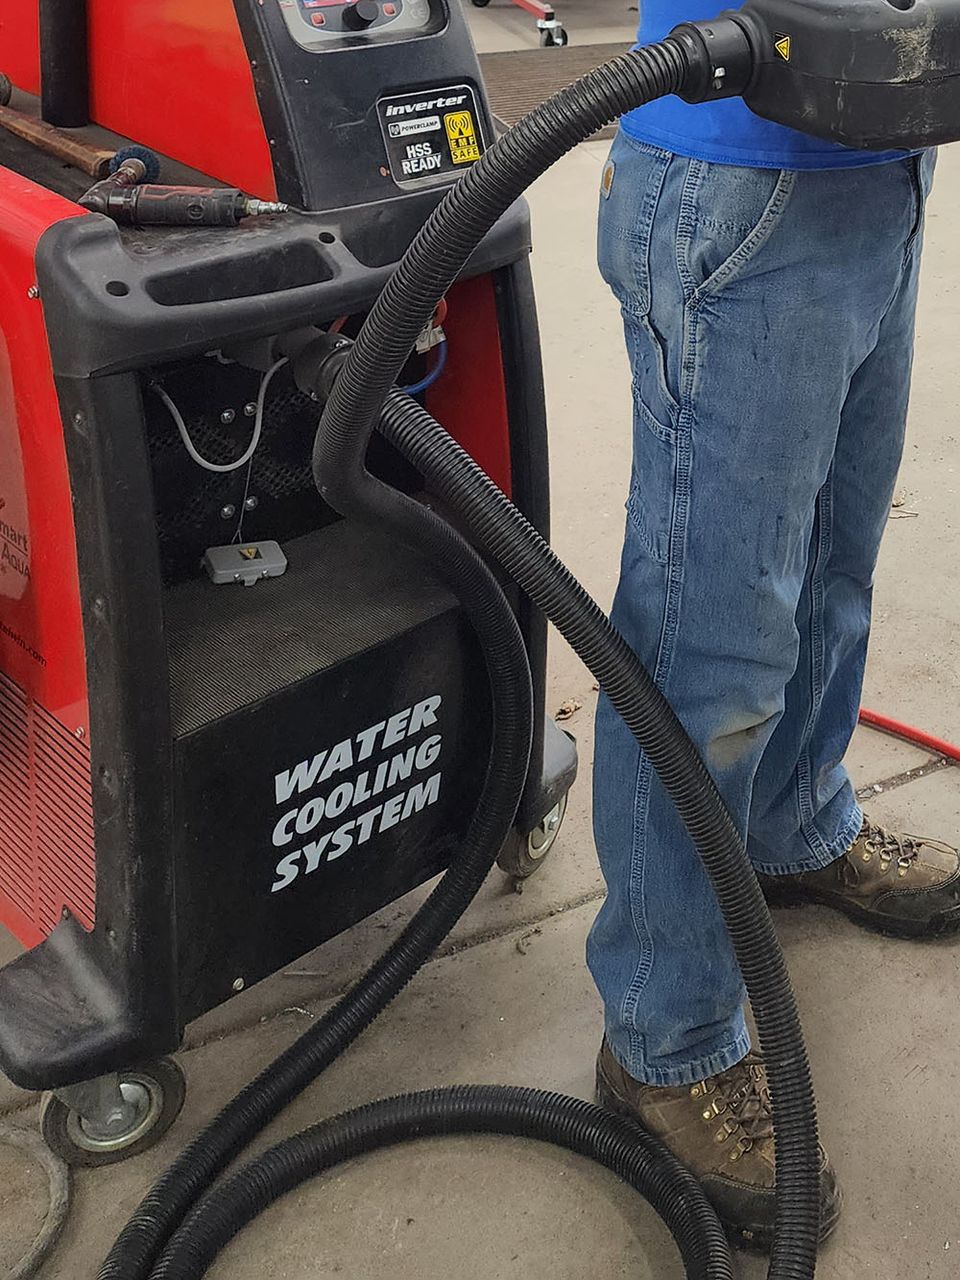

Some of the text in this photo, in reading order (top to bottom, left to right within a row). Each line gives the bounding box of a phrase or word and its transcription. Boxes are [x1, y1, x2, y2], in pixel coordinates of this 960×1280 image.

[401, 120, 438, 132] POWERCLAMP
[406, 142, 432, 158] HSS
[452, 137, 475, 148] EMF
[453, 148, 478, 159] SAFE
[401, 155, 441, 174] READY
[274, 695, 442, 805] WATER
[272, 734, 442, 847] COOLING
[271, 772, 442, 893] SYSTEM
